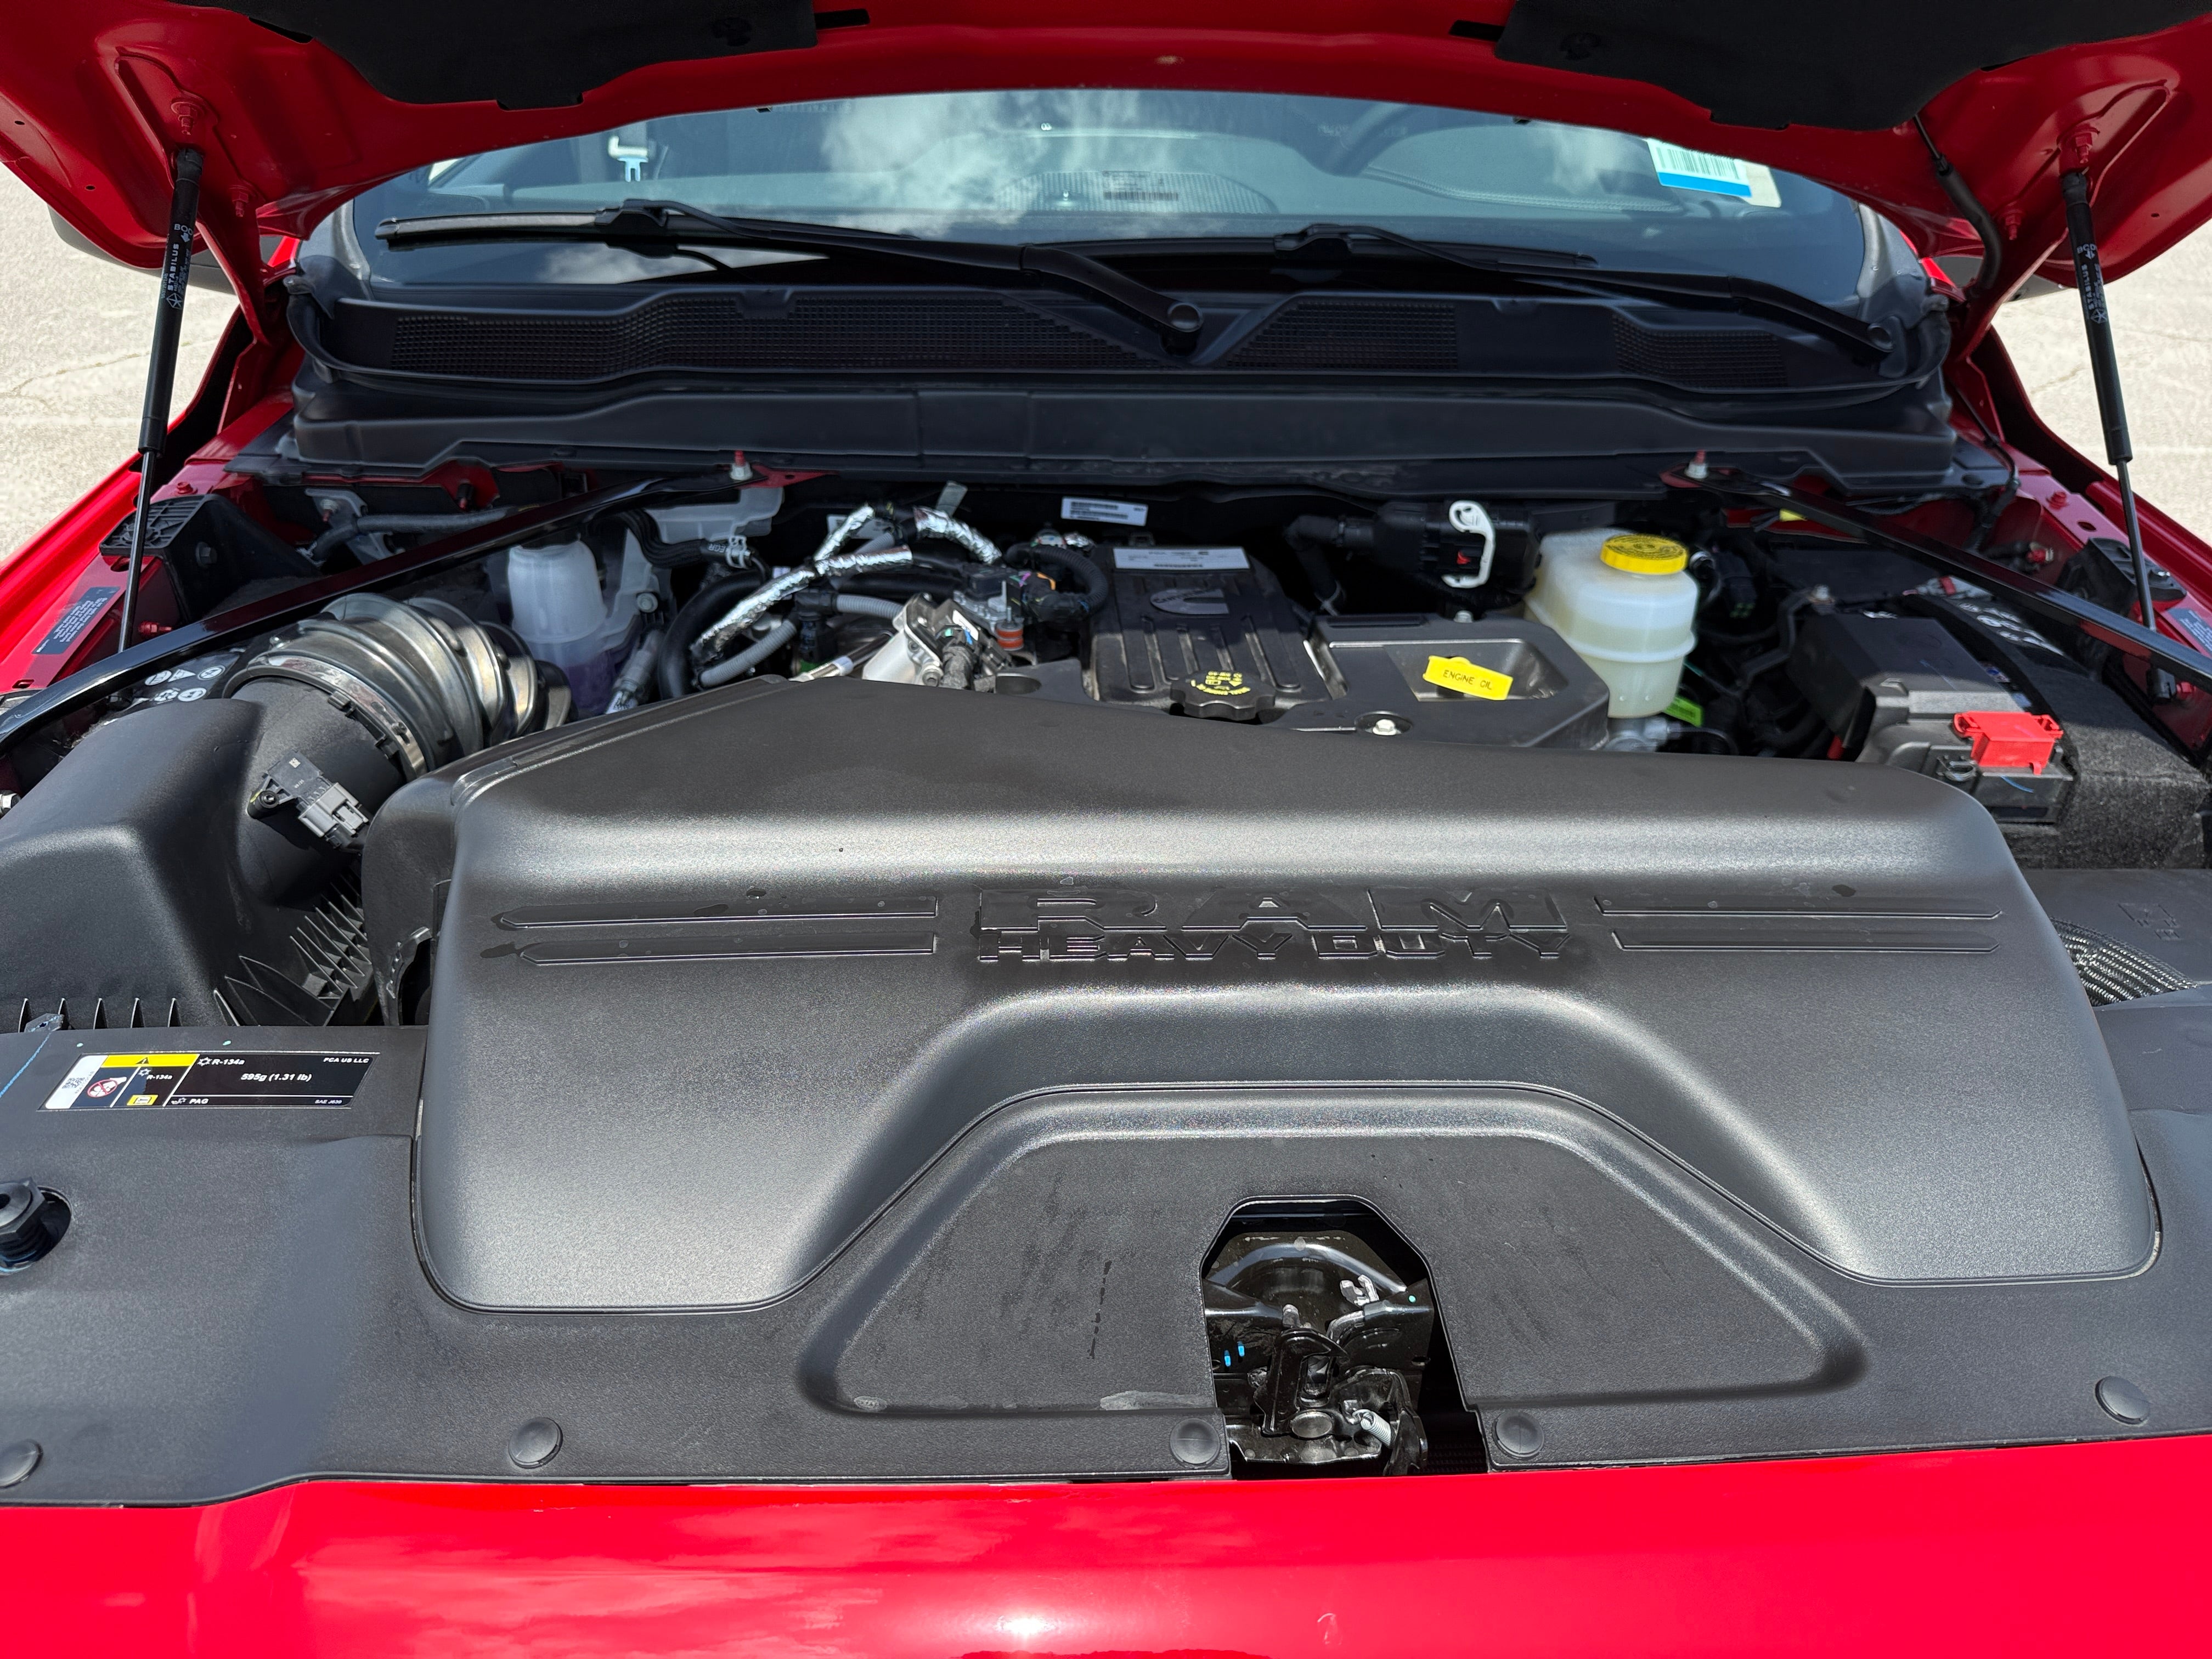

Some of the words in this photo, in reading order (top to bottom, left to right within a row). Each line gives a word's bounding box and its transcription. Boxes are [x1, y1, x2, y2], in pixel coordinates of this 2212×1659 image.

[167, 243, 179, 291] STABILUS
[1443, 669, 1475, 685] ENGINE
[1480, 680, 1492, 690] OIL
[979, 888, 1567, 932] RAM
[978, 932, 1293, 961] HEAVY
[1312, 932, 1570, 960] DUTY
[240, 1073, 267, 1081] 595g
[297, 1074, 312, 1082] lb)
